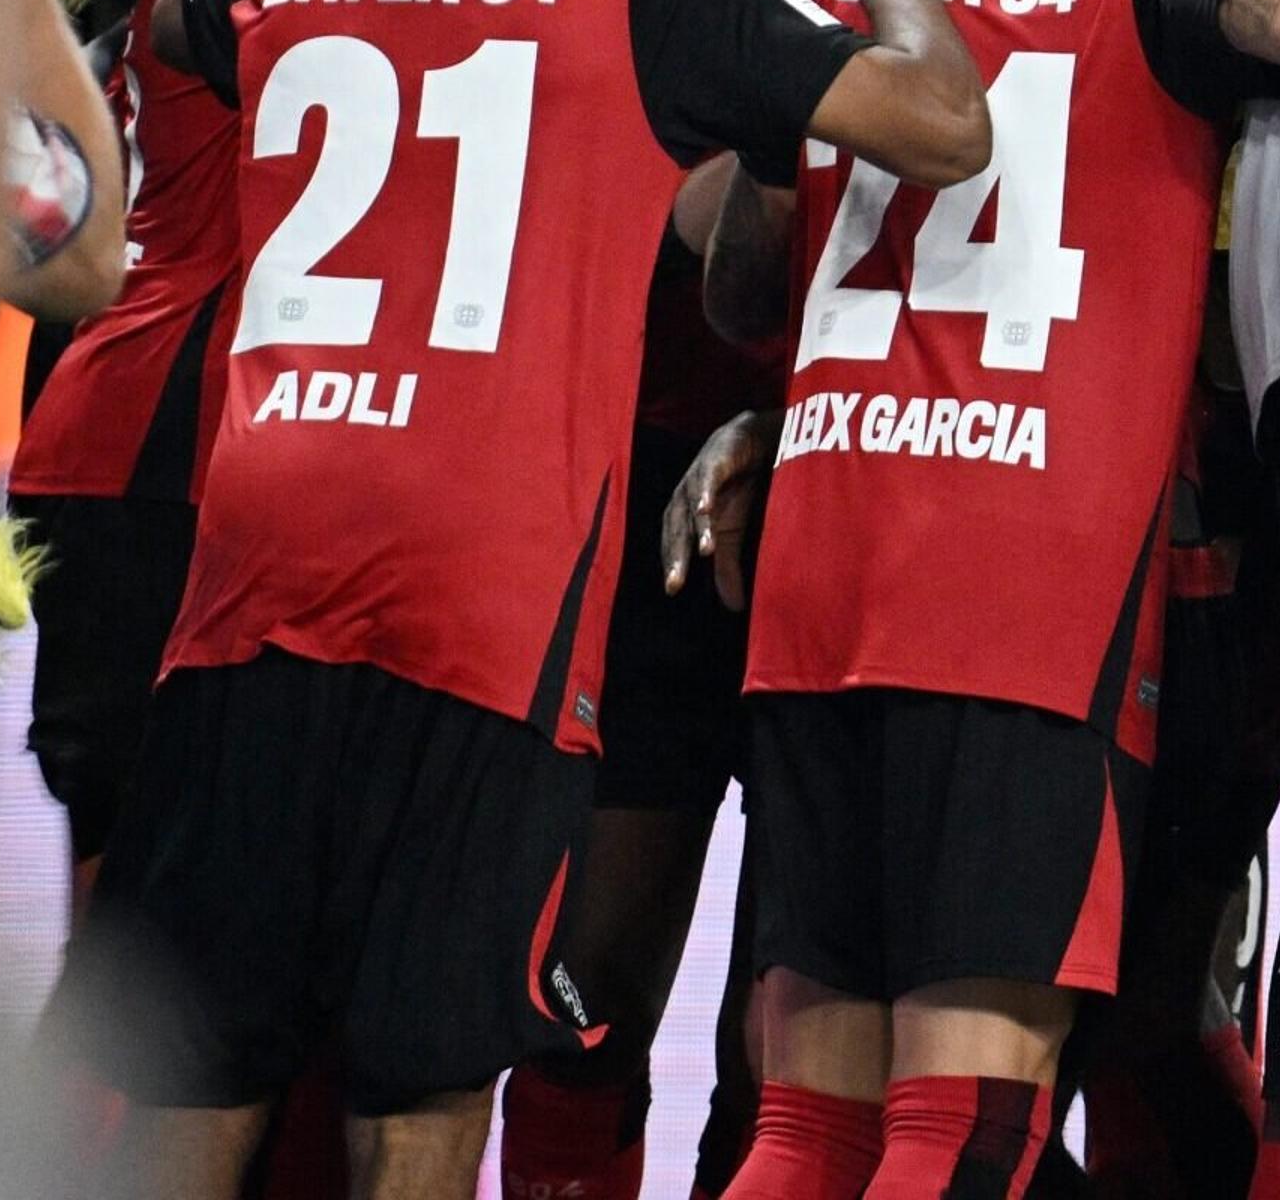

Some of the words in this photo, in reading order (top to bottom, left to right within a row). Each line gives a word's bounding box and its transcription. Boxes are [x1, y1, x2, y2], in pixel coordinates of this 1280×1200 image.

[230, 35, 538, 353] 21
[252, 369, 418, 428] ADLI
[860, 393, 1046, 471] GARCIA
